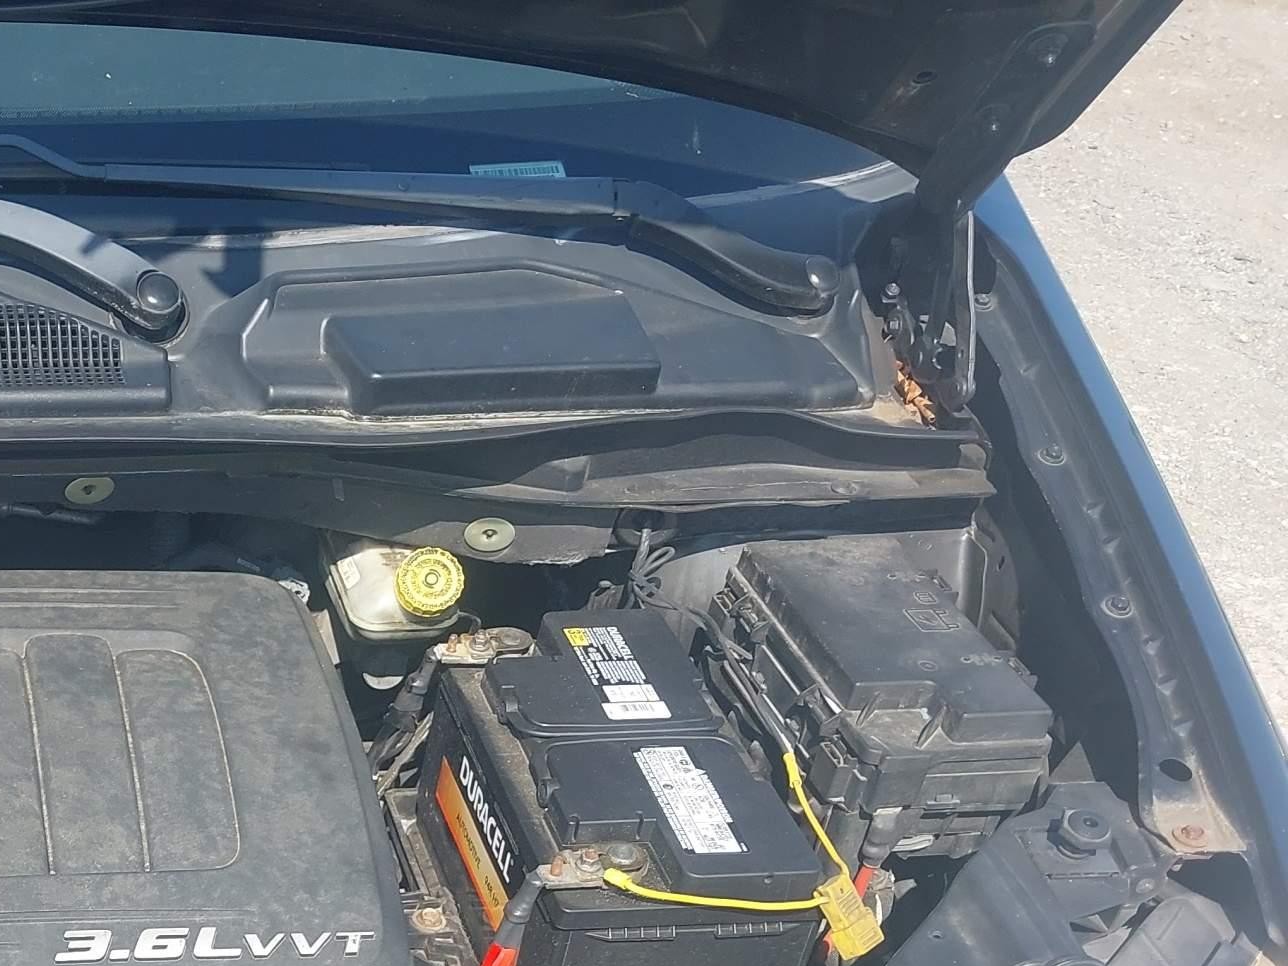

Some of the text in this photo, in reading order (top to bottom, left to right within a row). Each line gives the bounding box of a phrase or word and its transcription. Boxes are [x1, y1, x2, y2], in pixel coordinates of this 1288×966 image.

[607, 626, 634, 660] DURACELL
[456, 812, 481, 870] AUTOMOTIVE
[460, 755, 511, 884] DURACELL
